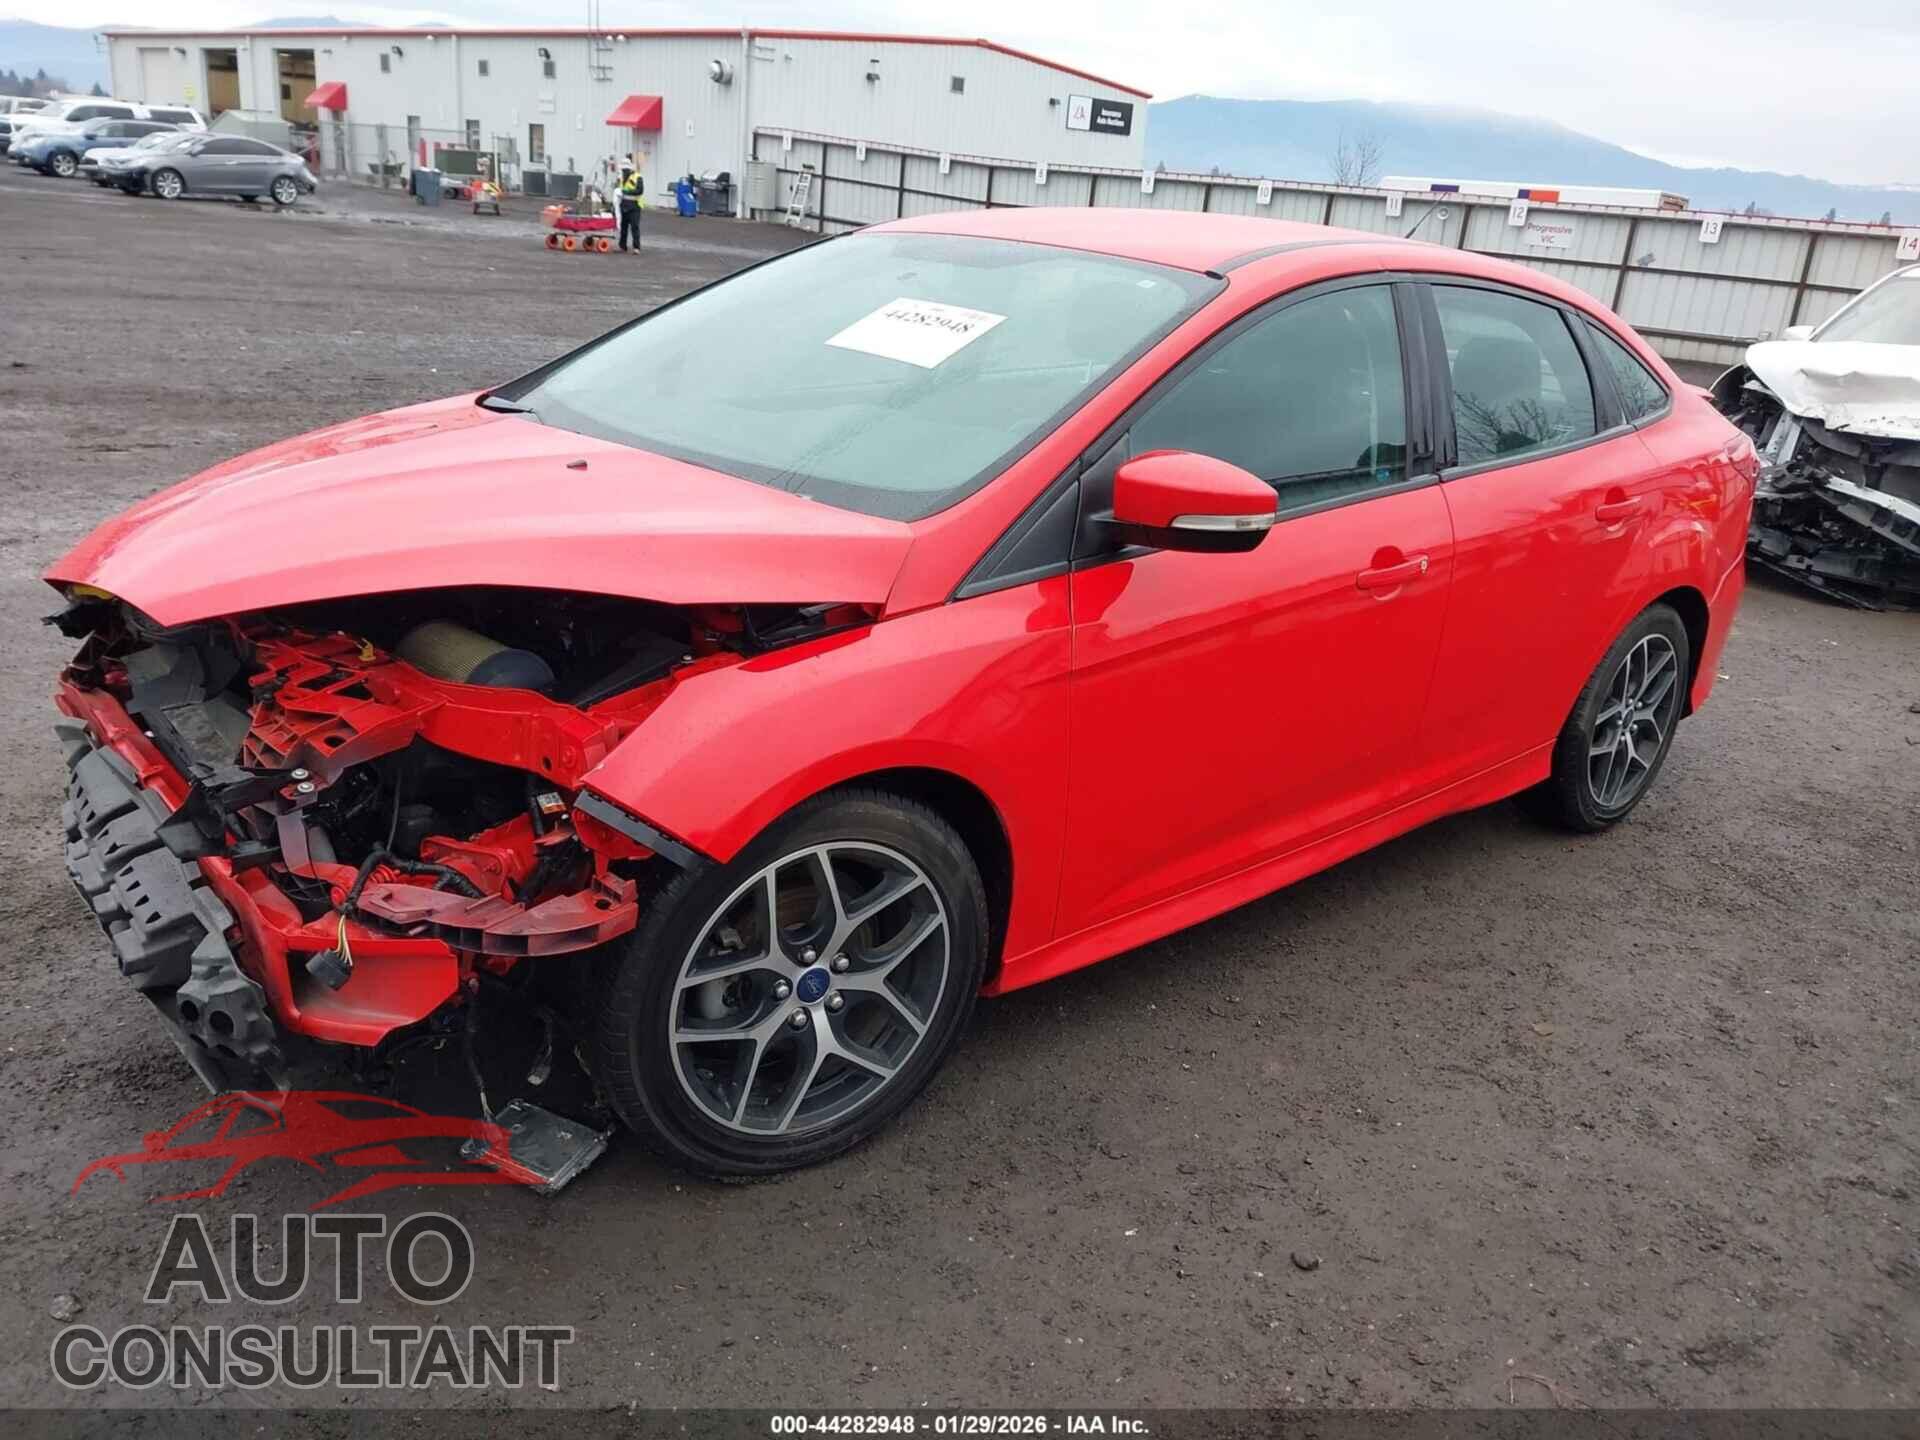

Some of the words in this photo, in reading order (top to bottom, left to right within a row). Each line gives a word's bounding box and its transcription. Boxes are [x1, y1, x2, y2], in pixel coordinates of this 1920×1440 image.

[1259, 183, 1270, 197] 10
[1389, 197, 1399, 210] 11
[1512, 204, 1524, 220] 12
[1528, 221, 1573, 235] Progressive
[1704, 220, 1719, 235] 13
[1902, 236, 1918, 251] 14
[885, 310, 975, 333] 44282948
